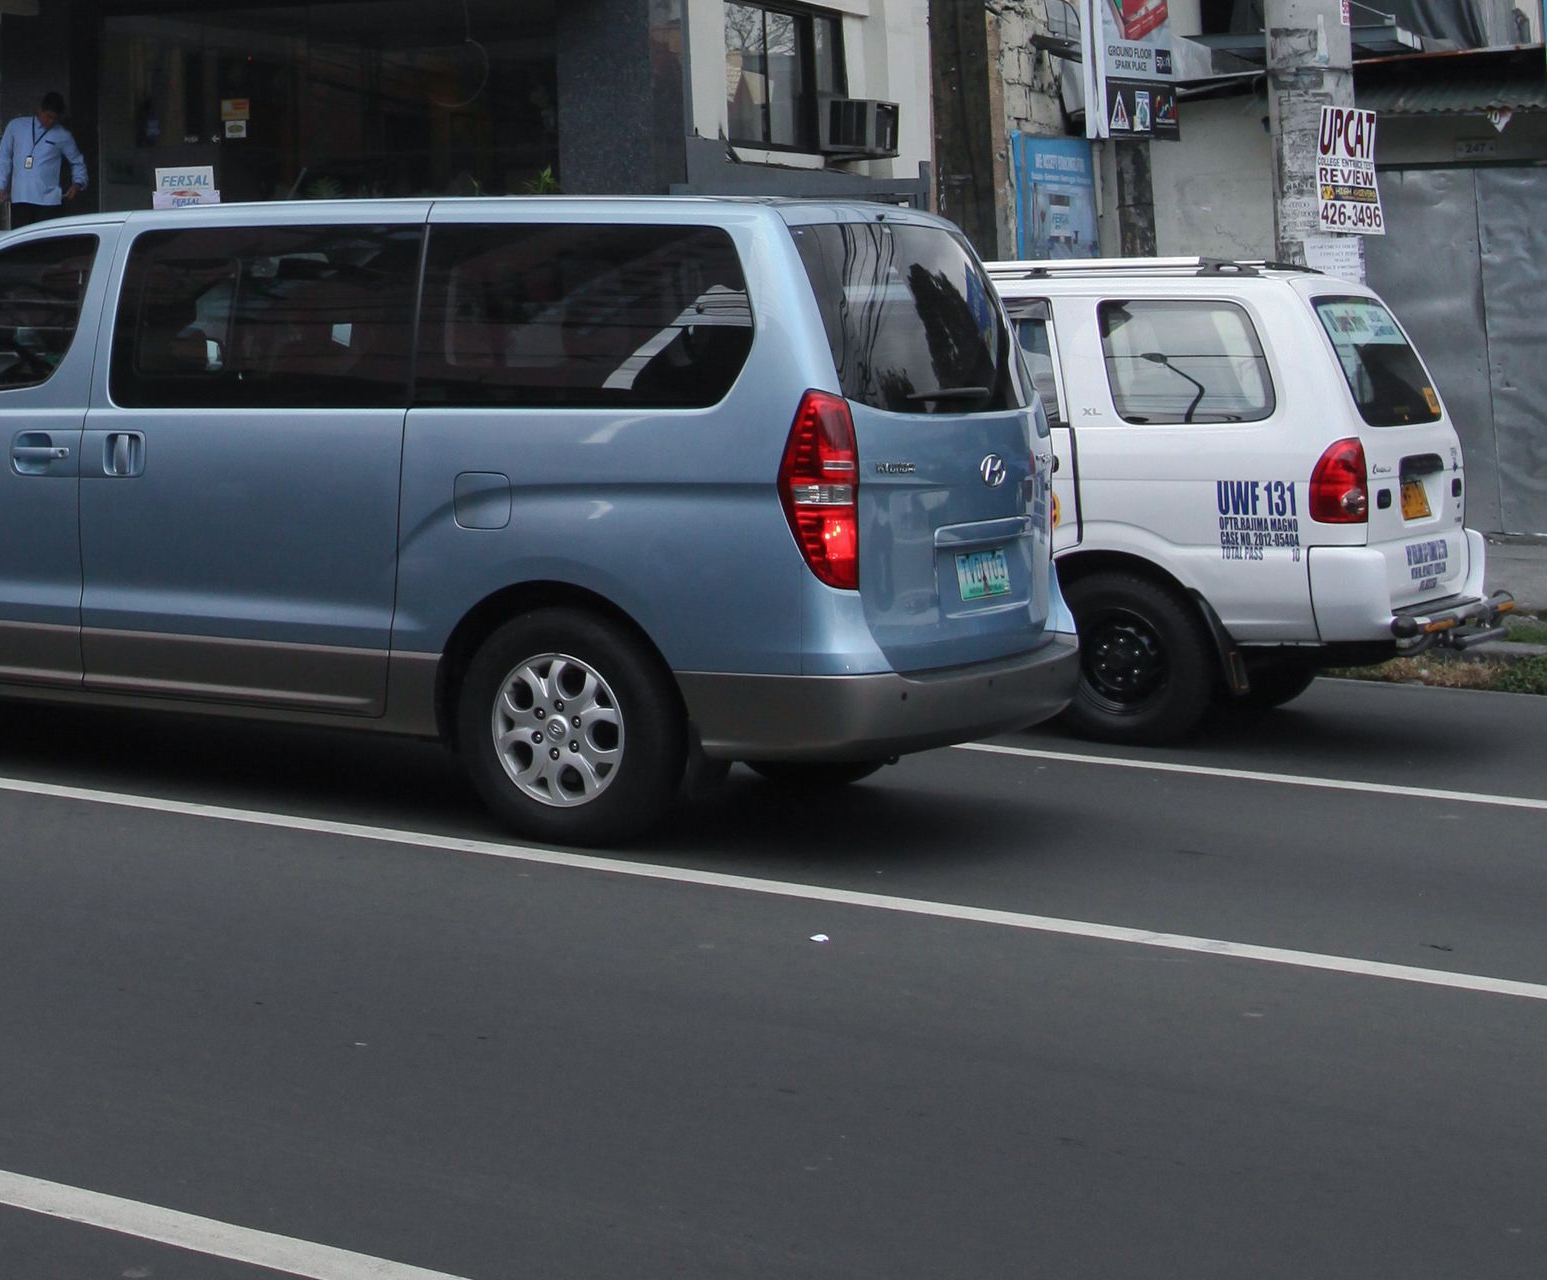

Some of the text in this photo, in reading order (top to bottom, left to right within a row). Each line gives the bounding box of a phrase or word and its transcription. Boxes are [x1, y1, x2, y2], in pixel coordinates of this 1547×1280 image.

[1108, 45, 1151, 60] GROUND FLOOR
[1115, 60, 1147, 71] SPARK PLACE
[1319, 108, 1375, 159] UPCAT
[1317, 157, 1340, 167] COLLEGE
[161, 175, 209, 187] FERSAL
[1319, 167, 1374, 186] REVIEW
[172, 198, 199, 207] FERSAL
[1320, 202, 1382, 227] 426-3496
[1082, 406, 1102, 416] XL
[1217, 481, 1297, 517] UWF 131
[1220, 531, 1240, 545] CASE
[1221, 546, 1243, 560] TOTAL
[1244, 547, 1263, 560] PASS
